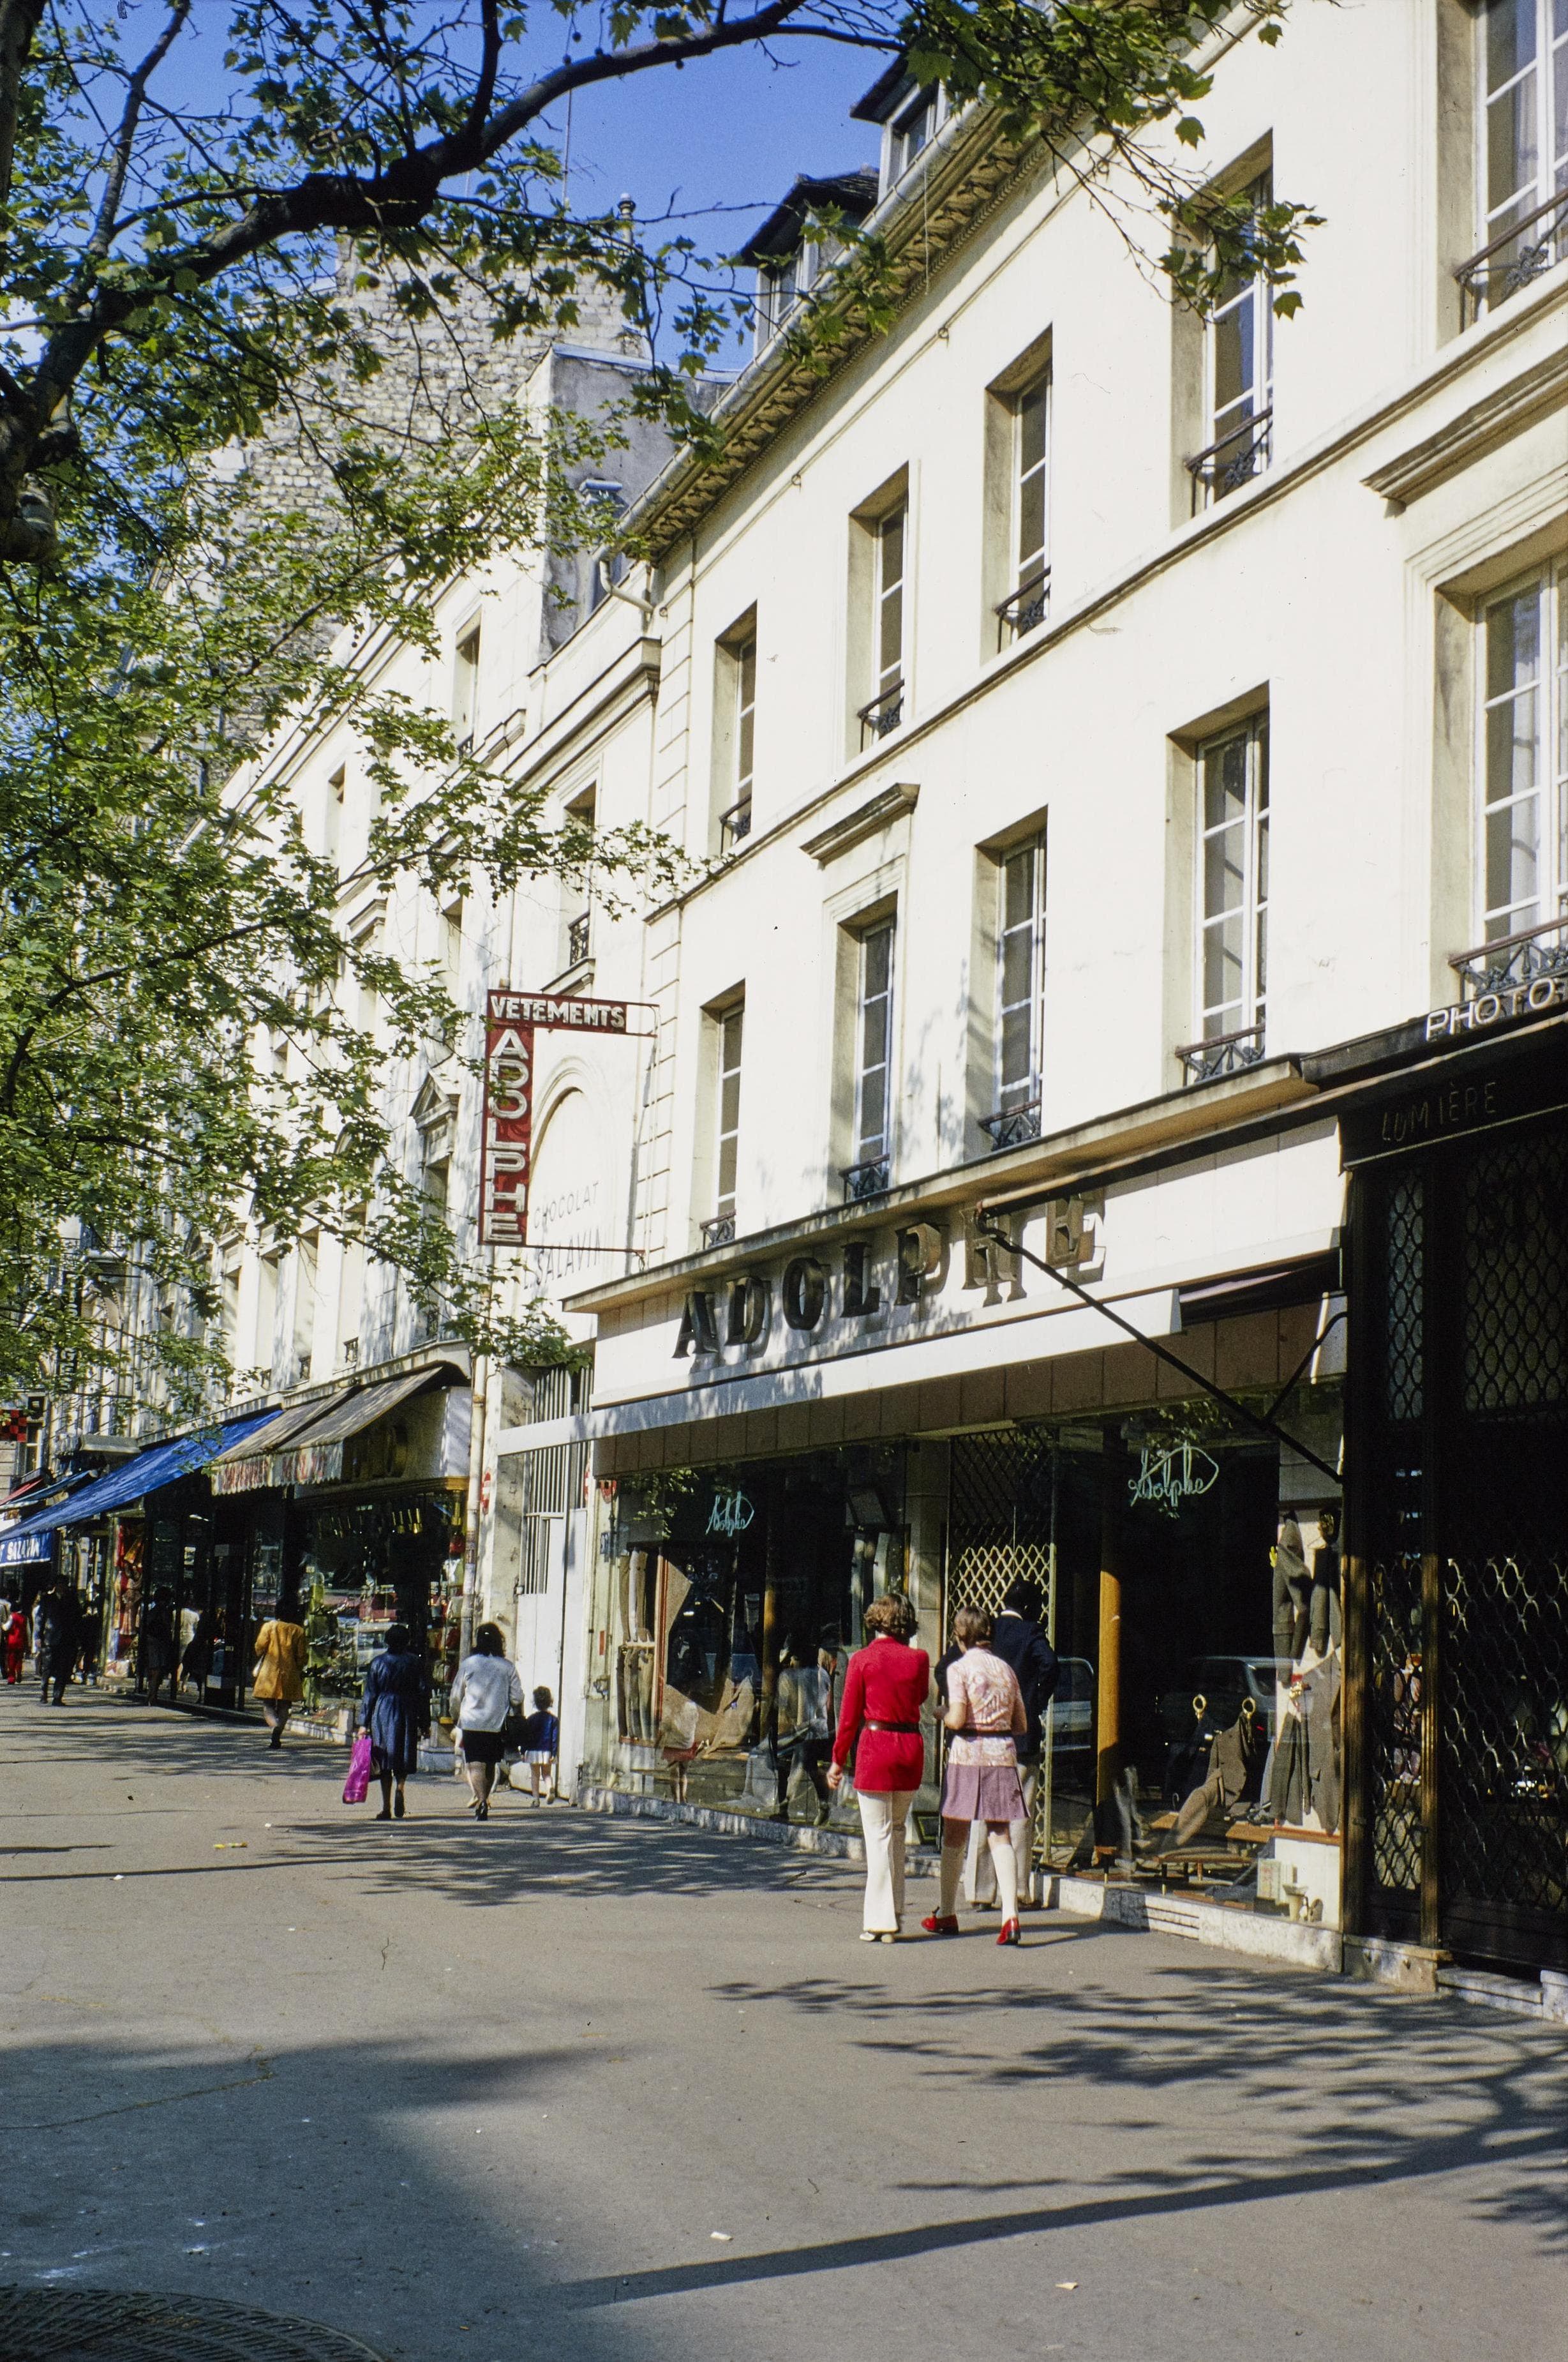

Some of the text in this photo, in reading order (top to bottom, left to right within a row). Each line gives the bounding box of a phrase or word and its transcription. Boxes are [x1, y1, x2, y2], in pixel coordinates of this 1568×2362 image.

[489, 995, 624, 1028] VETEMENTS
[1425, 977, 1556, 1041] PHOTO
[483, 1028, 529, 1242] ADOLPHE
[1382, 1082, 1496, 1141] LUMIÈRE
[534, 1181, 599, 1228] CHOCOLAT
[672, 1192, 1095, 1358] ADOLPHE
